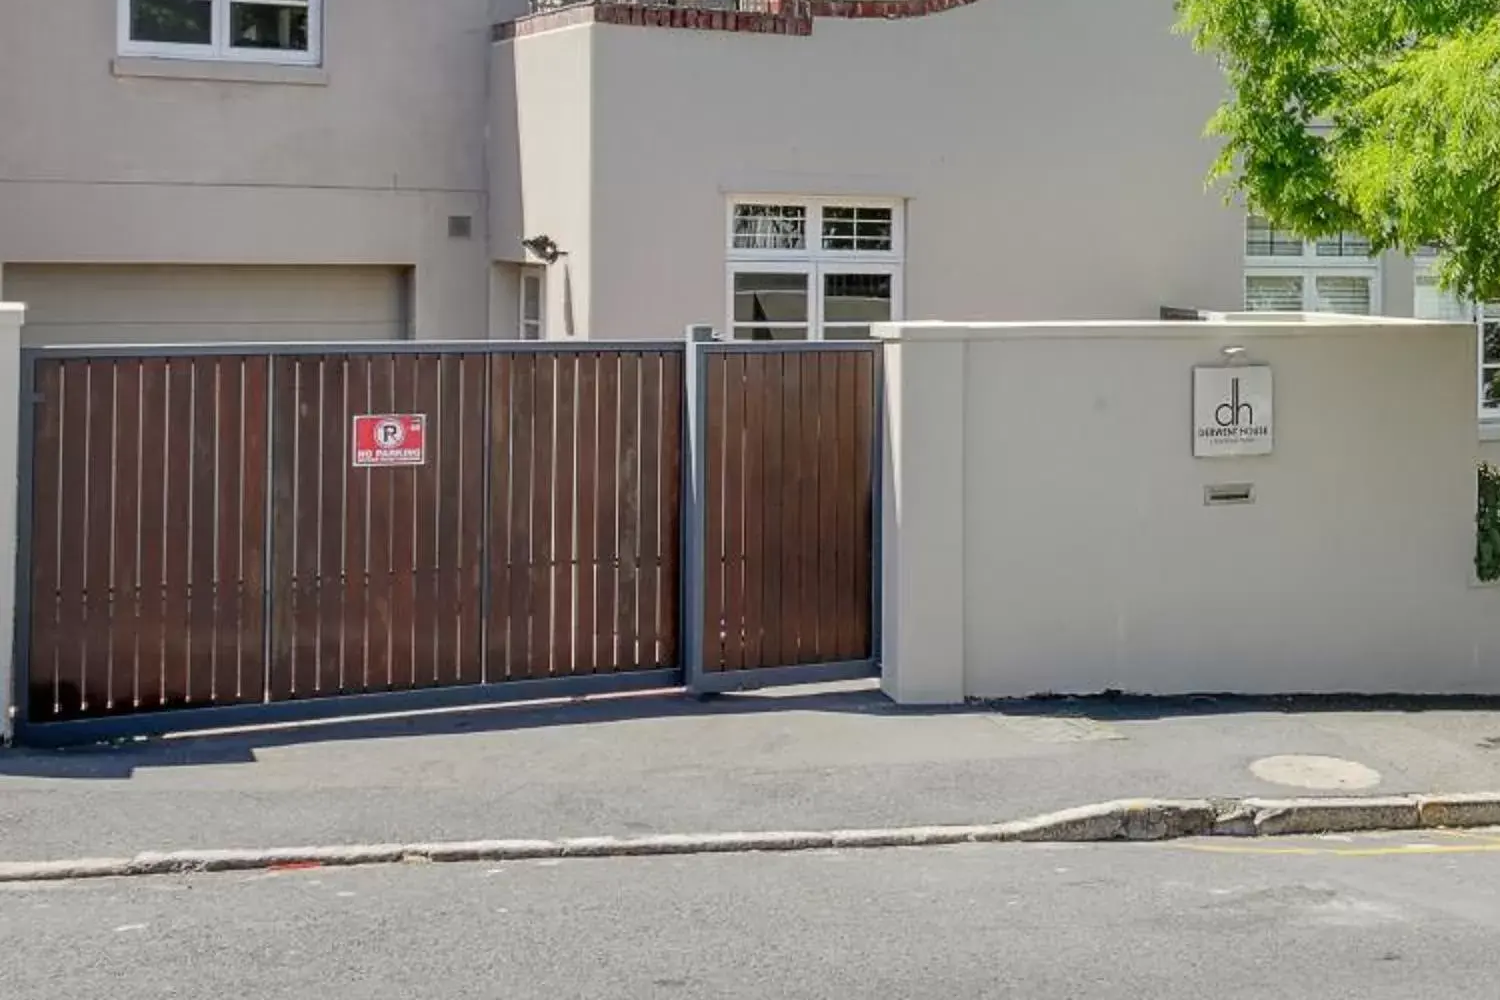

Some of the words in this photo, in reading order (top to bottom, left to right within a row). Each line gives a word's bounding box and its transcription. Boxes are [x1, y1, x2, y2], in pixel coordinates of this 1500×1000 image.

[1215, 377, 1253, 427] dh
[1239, 425, 1268, 437] HOUSE
[357, 449, 373, 458] NO
[375, 448, 420, 457] PARKING
